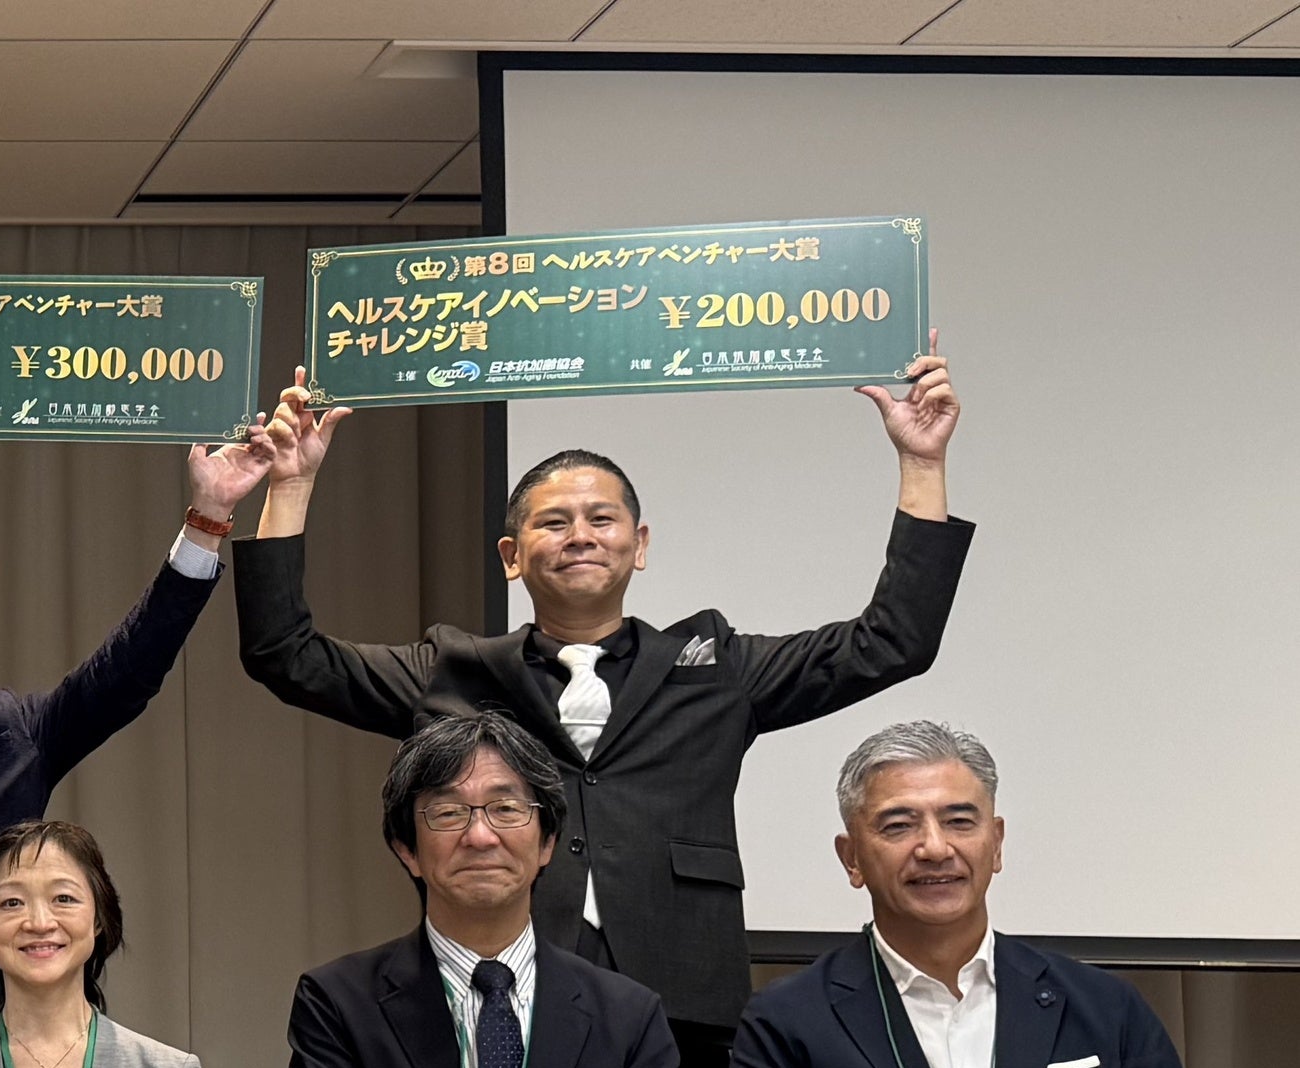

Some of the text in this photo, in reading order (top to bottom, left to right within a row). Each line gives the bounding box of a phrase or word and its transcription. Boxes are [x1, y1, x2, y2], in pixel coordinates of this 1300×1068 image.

[464, 237, 820, 277] 第8回 ヘルスケアベンチャー大賞
[327, 284, 648, 327] ヘルスケアイノベーション
[658, 286, 890, 330] ¥200,000
[327, 320, 488, 358] チャレンジ賞
[10, 345, 224, 385] ¥300,000
[489, 357, 584, 374] 日本抗加齢協会
